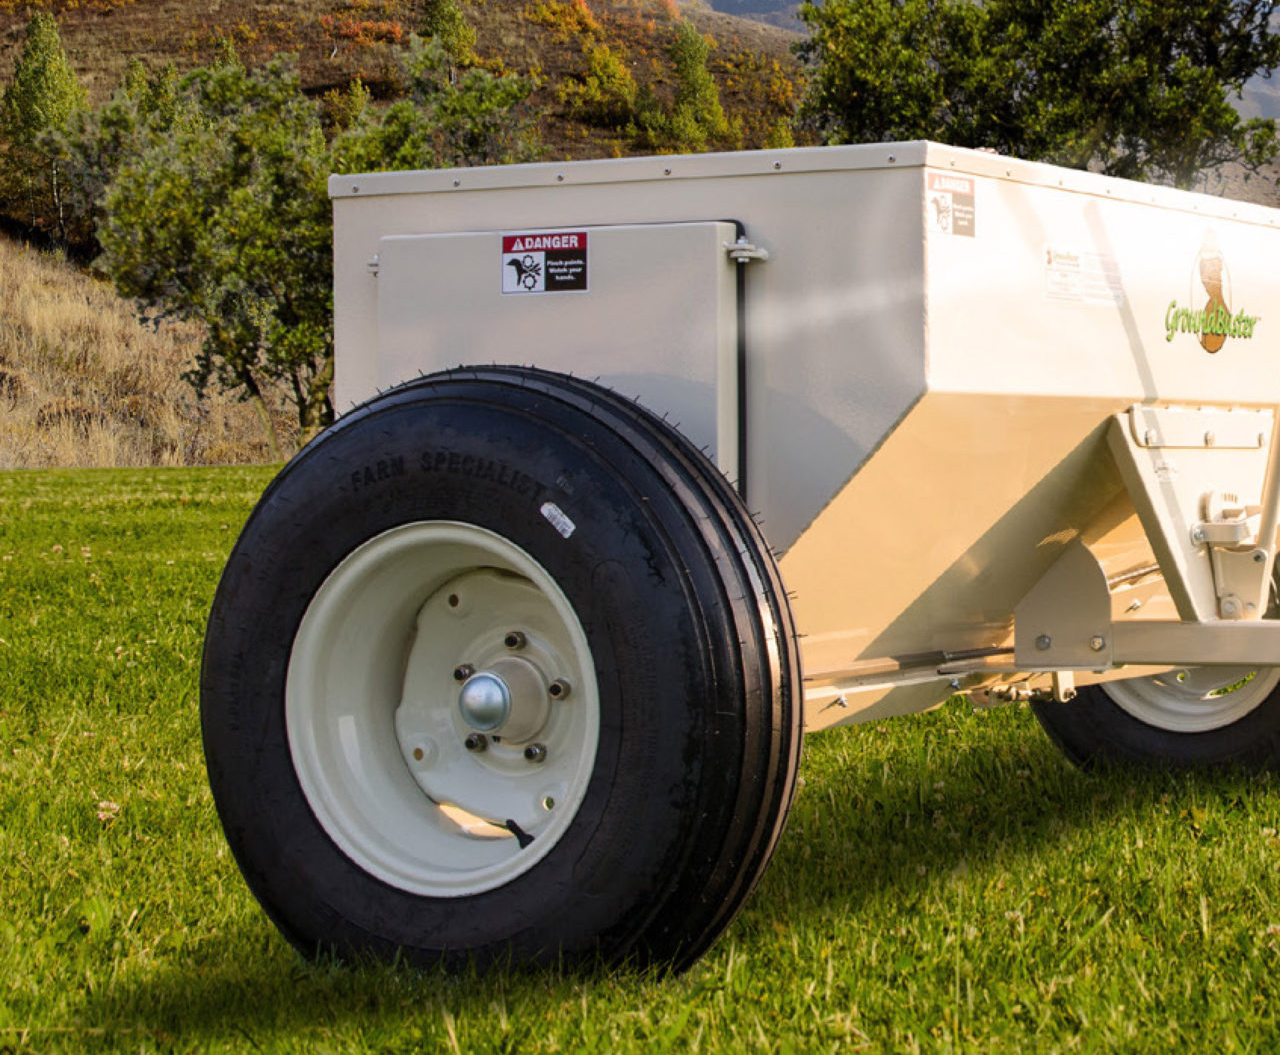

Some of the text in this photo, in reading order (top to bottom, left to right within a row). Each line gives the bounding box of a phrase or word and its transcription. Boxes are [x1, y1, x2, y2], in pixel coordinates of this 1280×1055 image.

[525, 235, 578, 249] DANGER
[1164, 298, 1257, 342] GroundBuster
[420, 451, 547, 502] SPECIALIST
